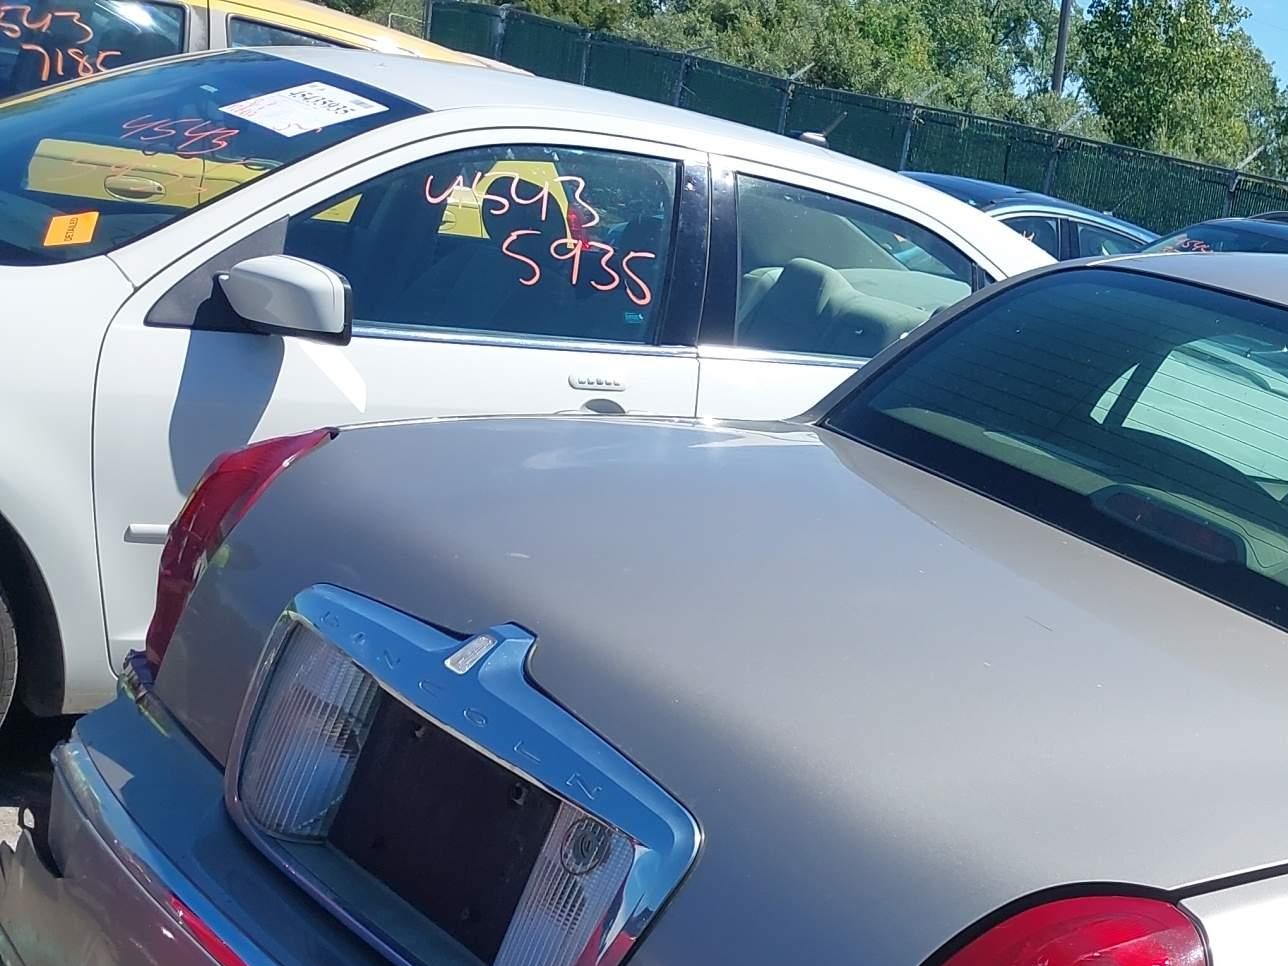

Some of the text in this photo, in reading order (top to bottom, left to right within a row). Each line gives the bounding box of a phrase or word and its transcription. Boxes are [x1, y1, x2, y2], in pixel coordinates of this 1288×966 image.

[120, 114, 240, 155] 4543
[502, 229, 656, 306] 5935
[320, 610, 603, 801] LINCOLN
